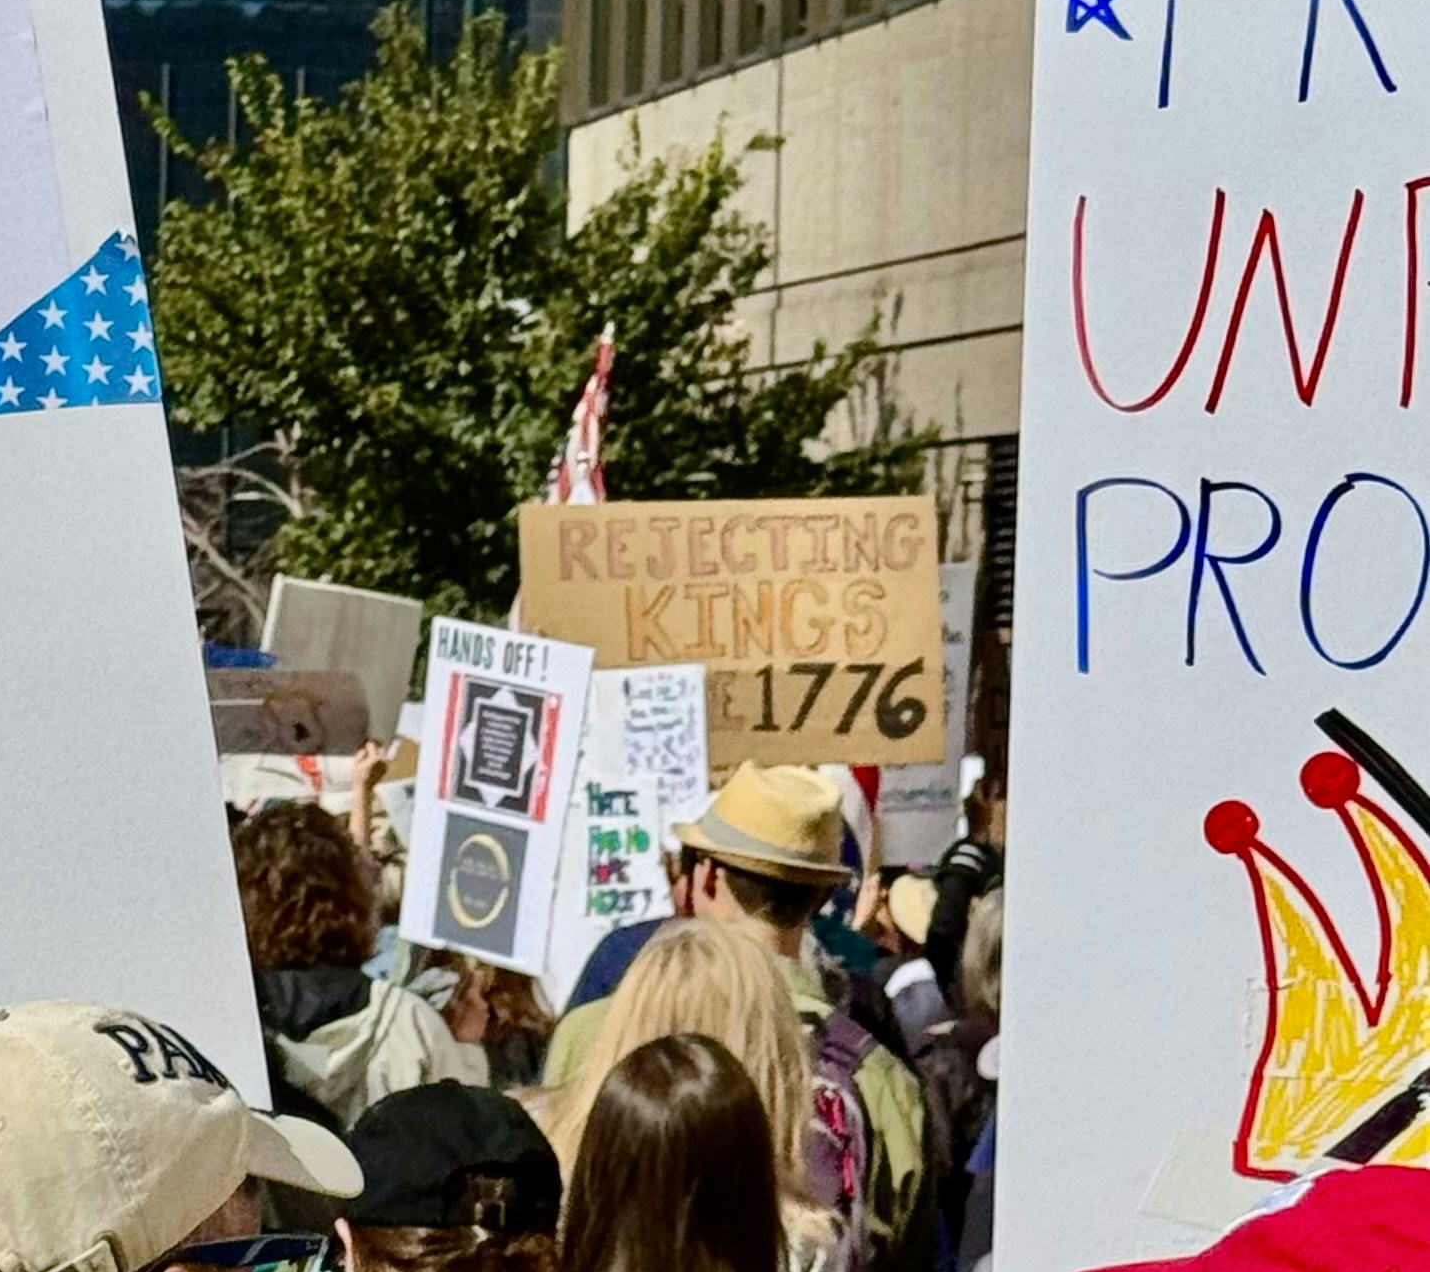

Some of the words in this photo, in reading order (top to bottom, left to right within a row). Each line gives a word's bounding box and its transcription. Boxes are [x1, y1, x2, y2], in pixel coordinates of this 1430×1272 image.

[558, 512, 926, 582] REJECTING
[1075, 471, 1430, 678] PRO
[436, 625, 496, 670] HANDS
[624, 578, 889, 662] KINGS
[751, 656, 928, 740] 1776
